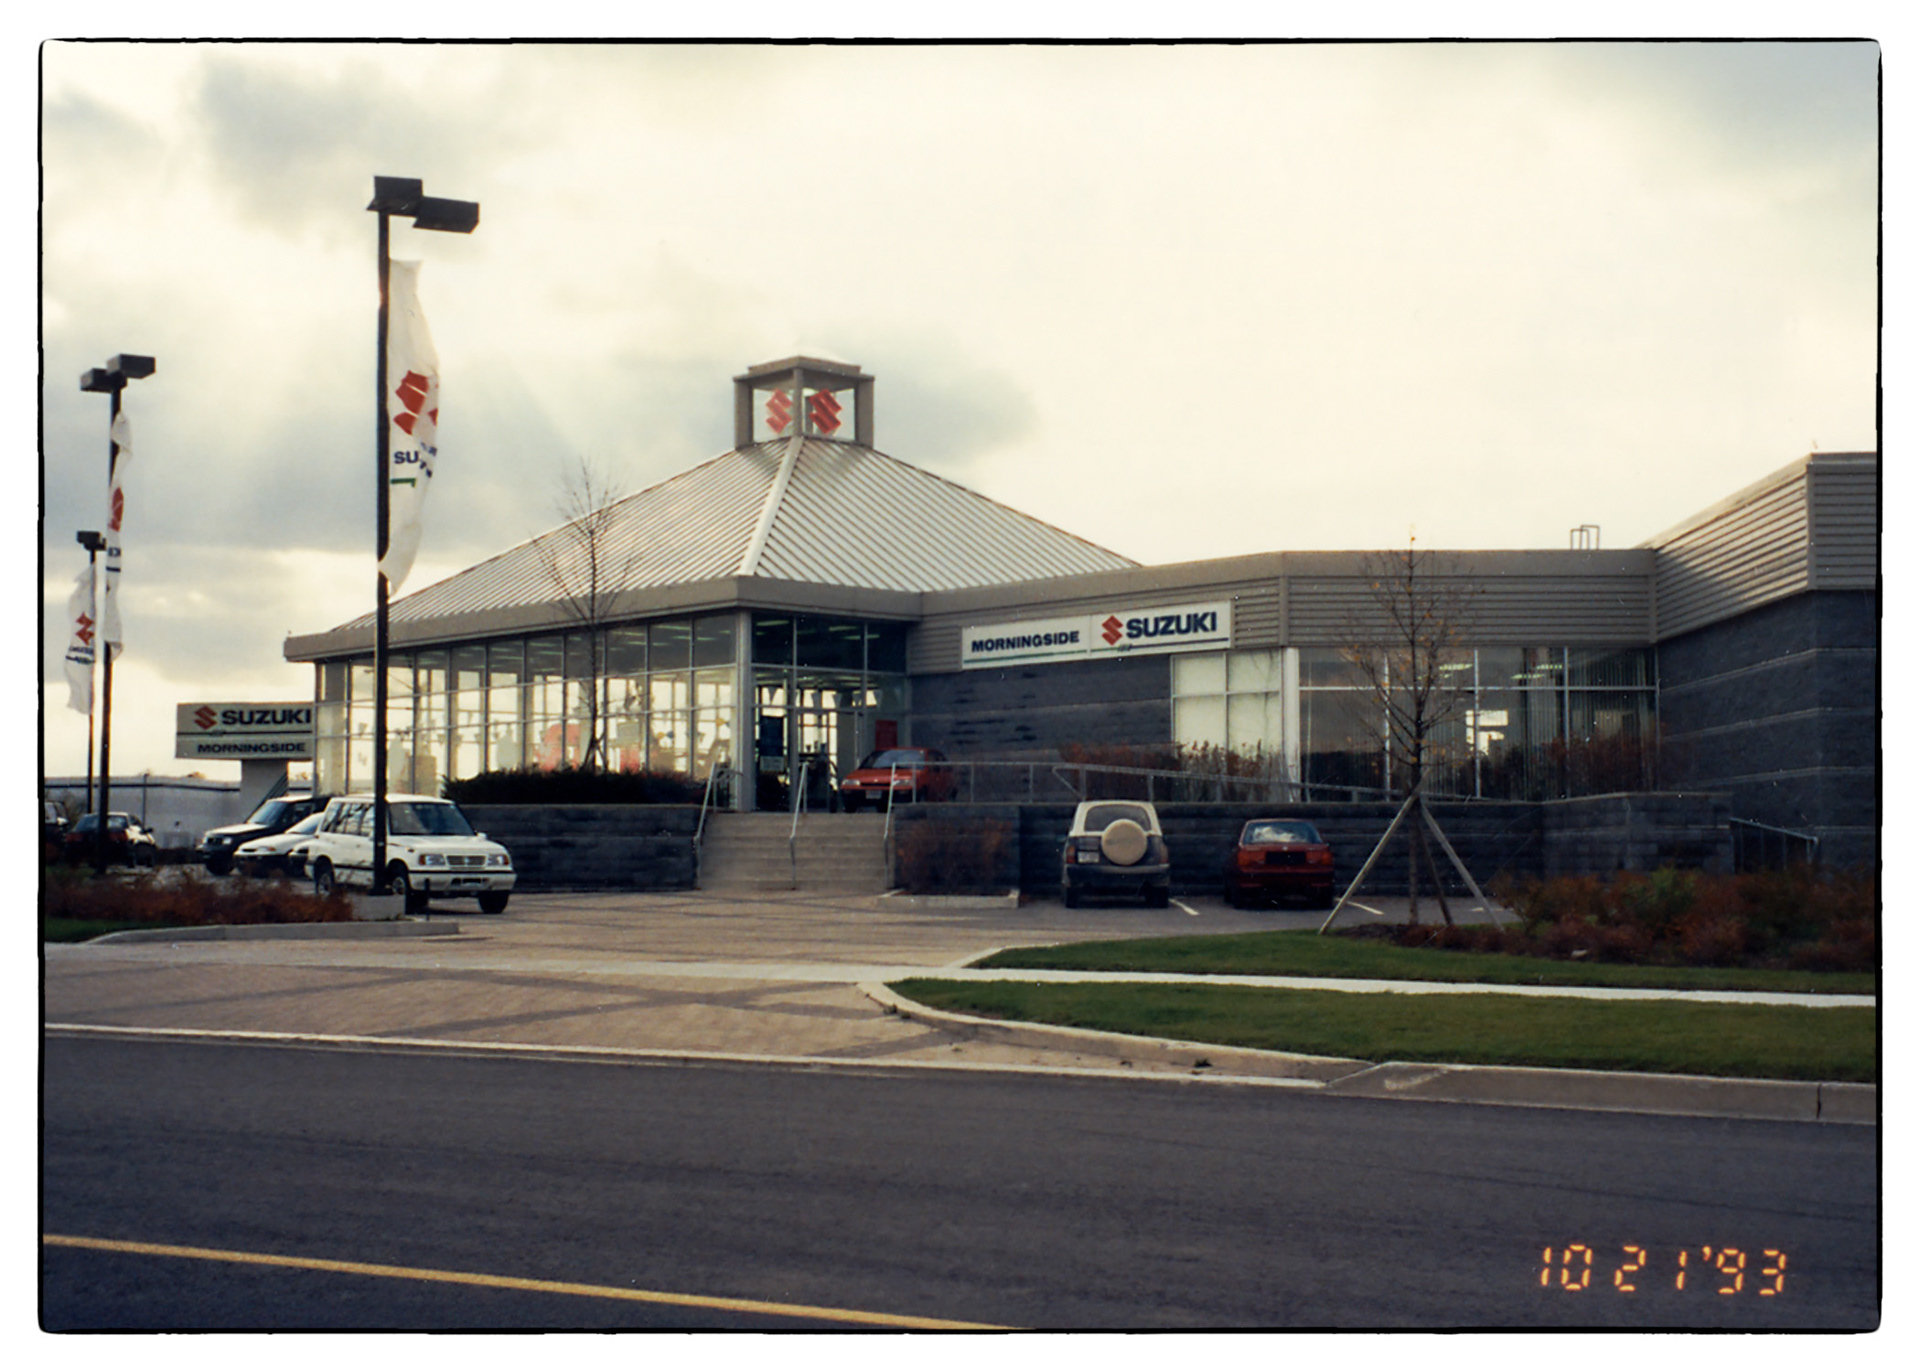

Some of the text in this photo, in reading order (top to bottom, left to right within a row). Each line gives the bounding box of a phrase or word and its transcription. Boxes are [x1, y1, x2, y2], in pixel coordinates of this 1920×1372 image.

[971, 611, 1218, 653] MORNINGSIDE SUZUKI
[221, 708, 311, 725] SUZUKI
[197, 742, 306, 754] MORNINGSIDE
